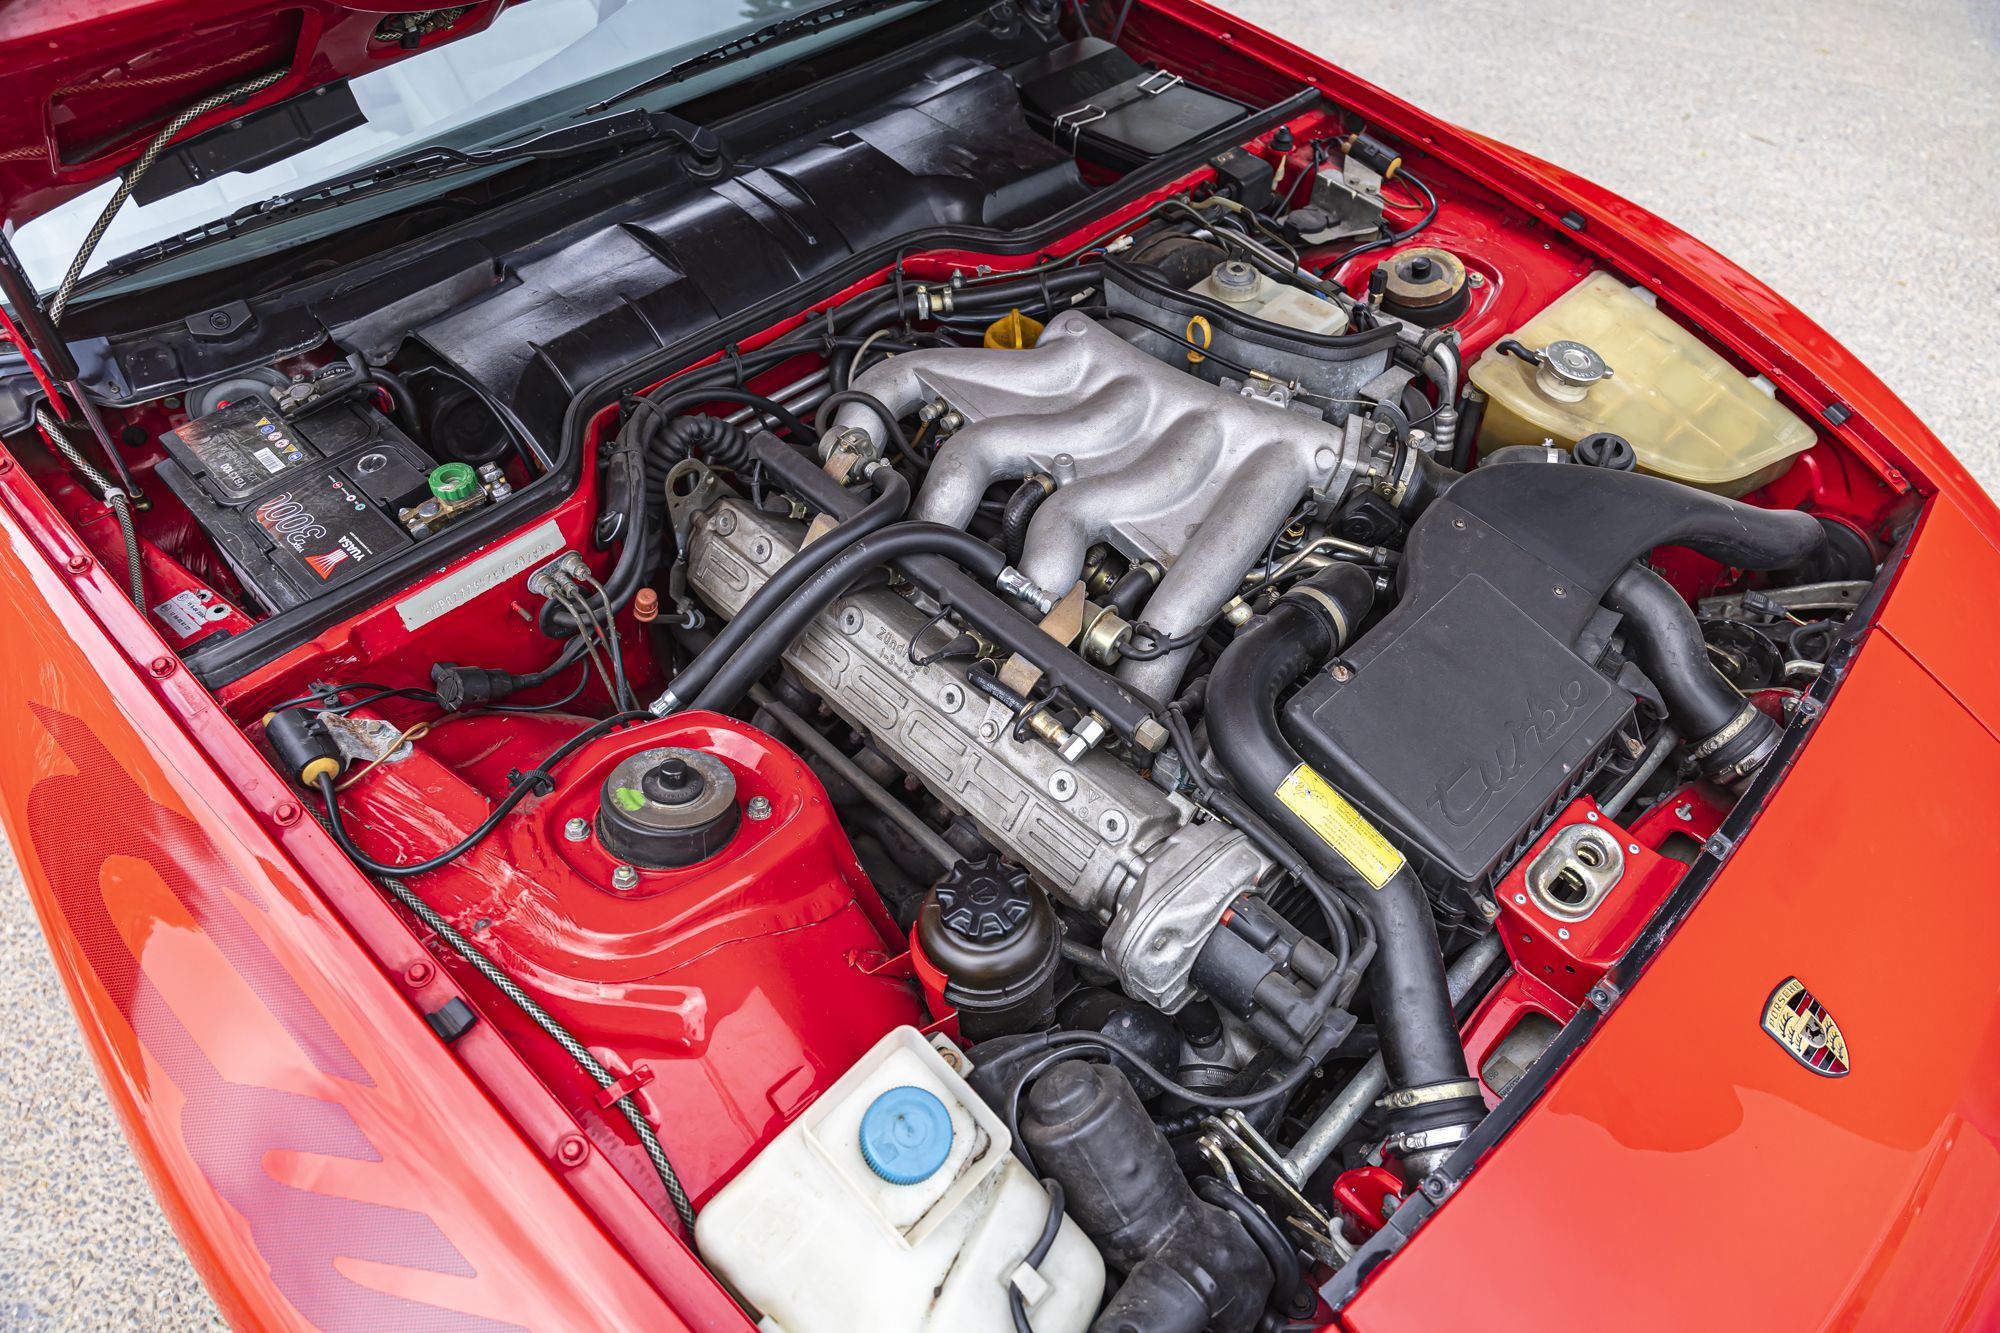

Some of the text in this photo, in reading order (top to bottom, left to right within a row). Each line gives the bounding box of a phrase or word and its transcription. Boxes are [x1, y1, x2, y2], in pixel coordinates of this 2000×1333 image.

[338, 535, 365, 562] YUASA
[700, 542, 1103, 886] PRSCHE
[1426, 676, 1590, 827] turbo
[1768, 981, 1801, 1029] PORSCHE
